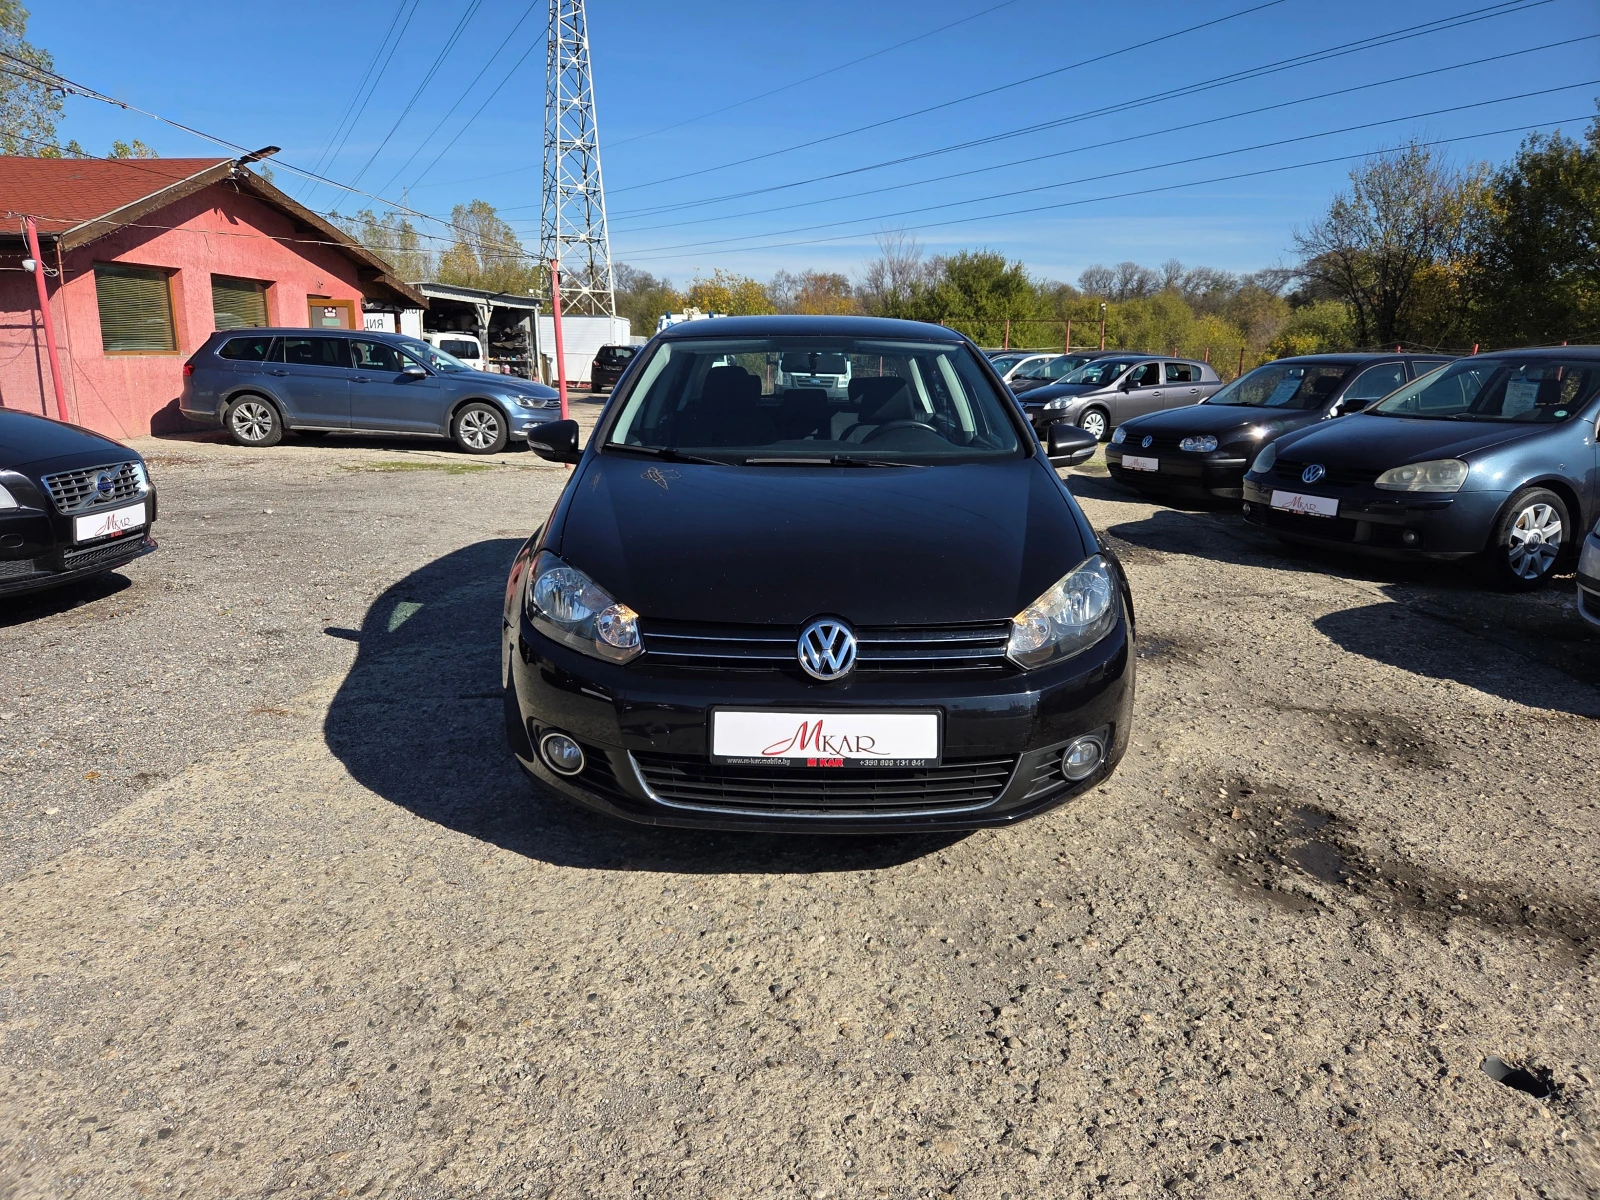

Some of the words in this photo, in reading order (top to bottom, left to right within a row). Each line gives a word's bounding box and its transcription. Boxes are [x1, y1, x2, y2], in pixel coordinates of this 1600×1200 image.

[761, 719, 891, 759] MKAR
[819, 758, 844, 768] KAR
[859, 759, 878, 767] +359
[895, 759, 910, 767] 131
